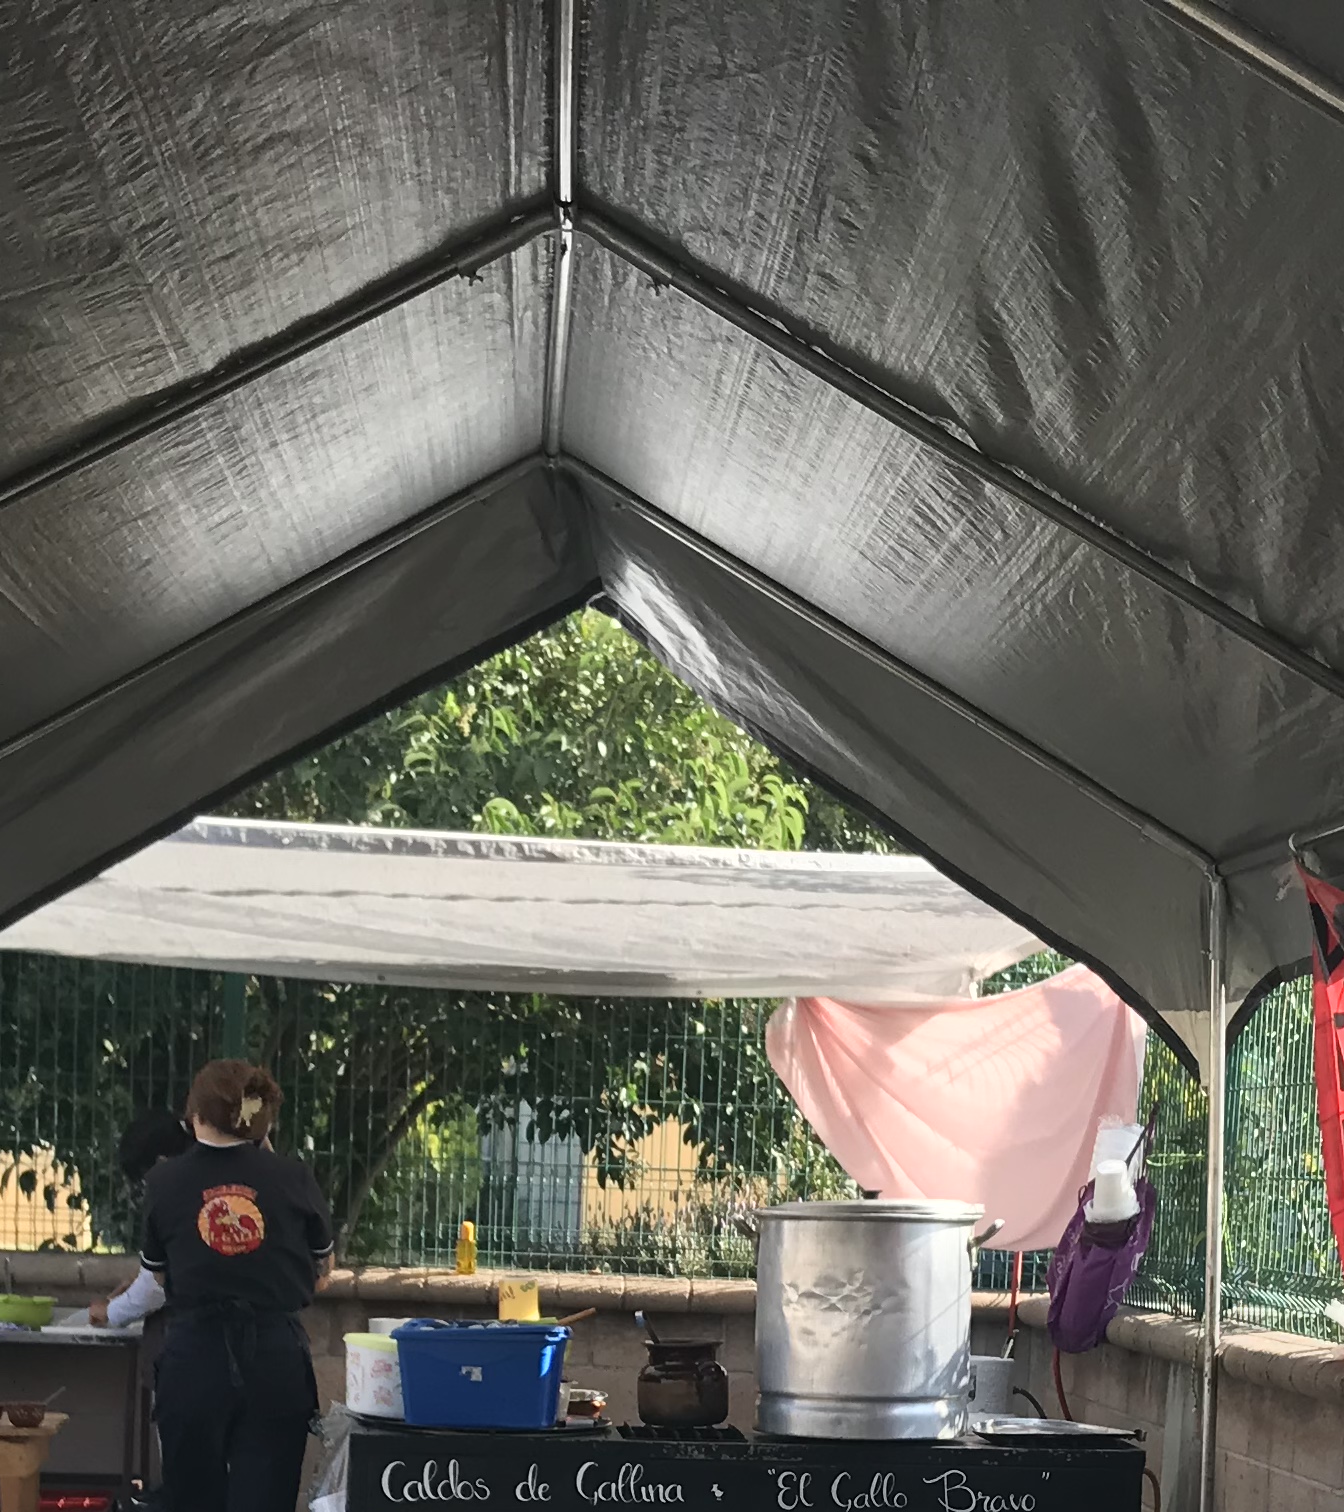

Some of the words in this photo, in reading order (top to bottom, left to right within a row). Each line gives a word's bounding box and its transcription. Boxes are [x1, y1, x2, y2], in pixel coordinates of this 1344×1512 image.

[379, 1459, 492, 1504] Caldos
[514, 1463, 553, 1504] de
[574, 1460, 686, 1508] Gallina
[830, 1471, 909, 1512] Gallo
